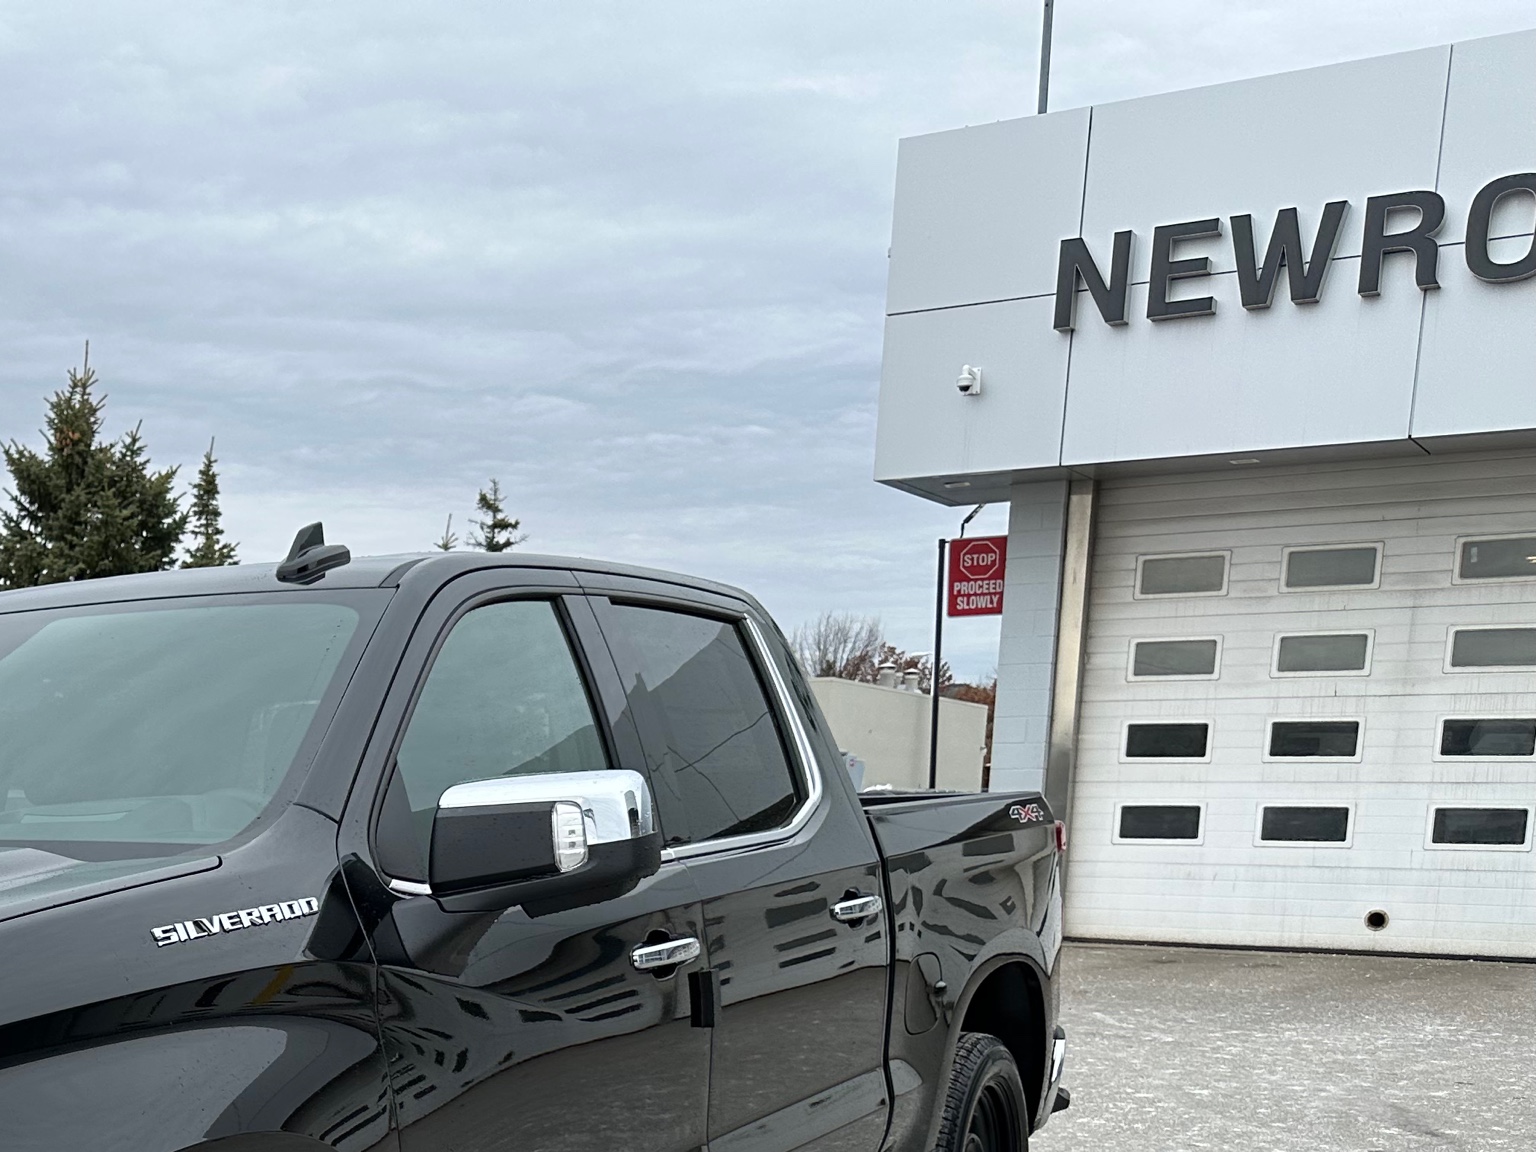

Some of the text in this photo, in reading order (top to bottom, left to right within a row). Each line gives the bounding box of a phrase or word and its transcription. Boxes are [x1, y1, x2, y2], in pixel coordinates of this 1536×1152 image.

[964, 553, 996, 567] STOP
[953, 580, 1003, 595] PROCEED
[956, 595, 1000, 610] SLOWLY
[150, 896, 319, 948] SILVERADO
